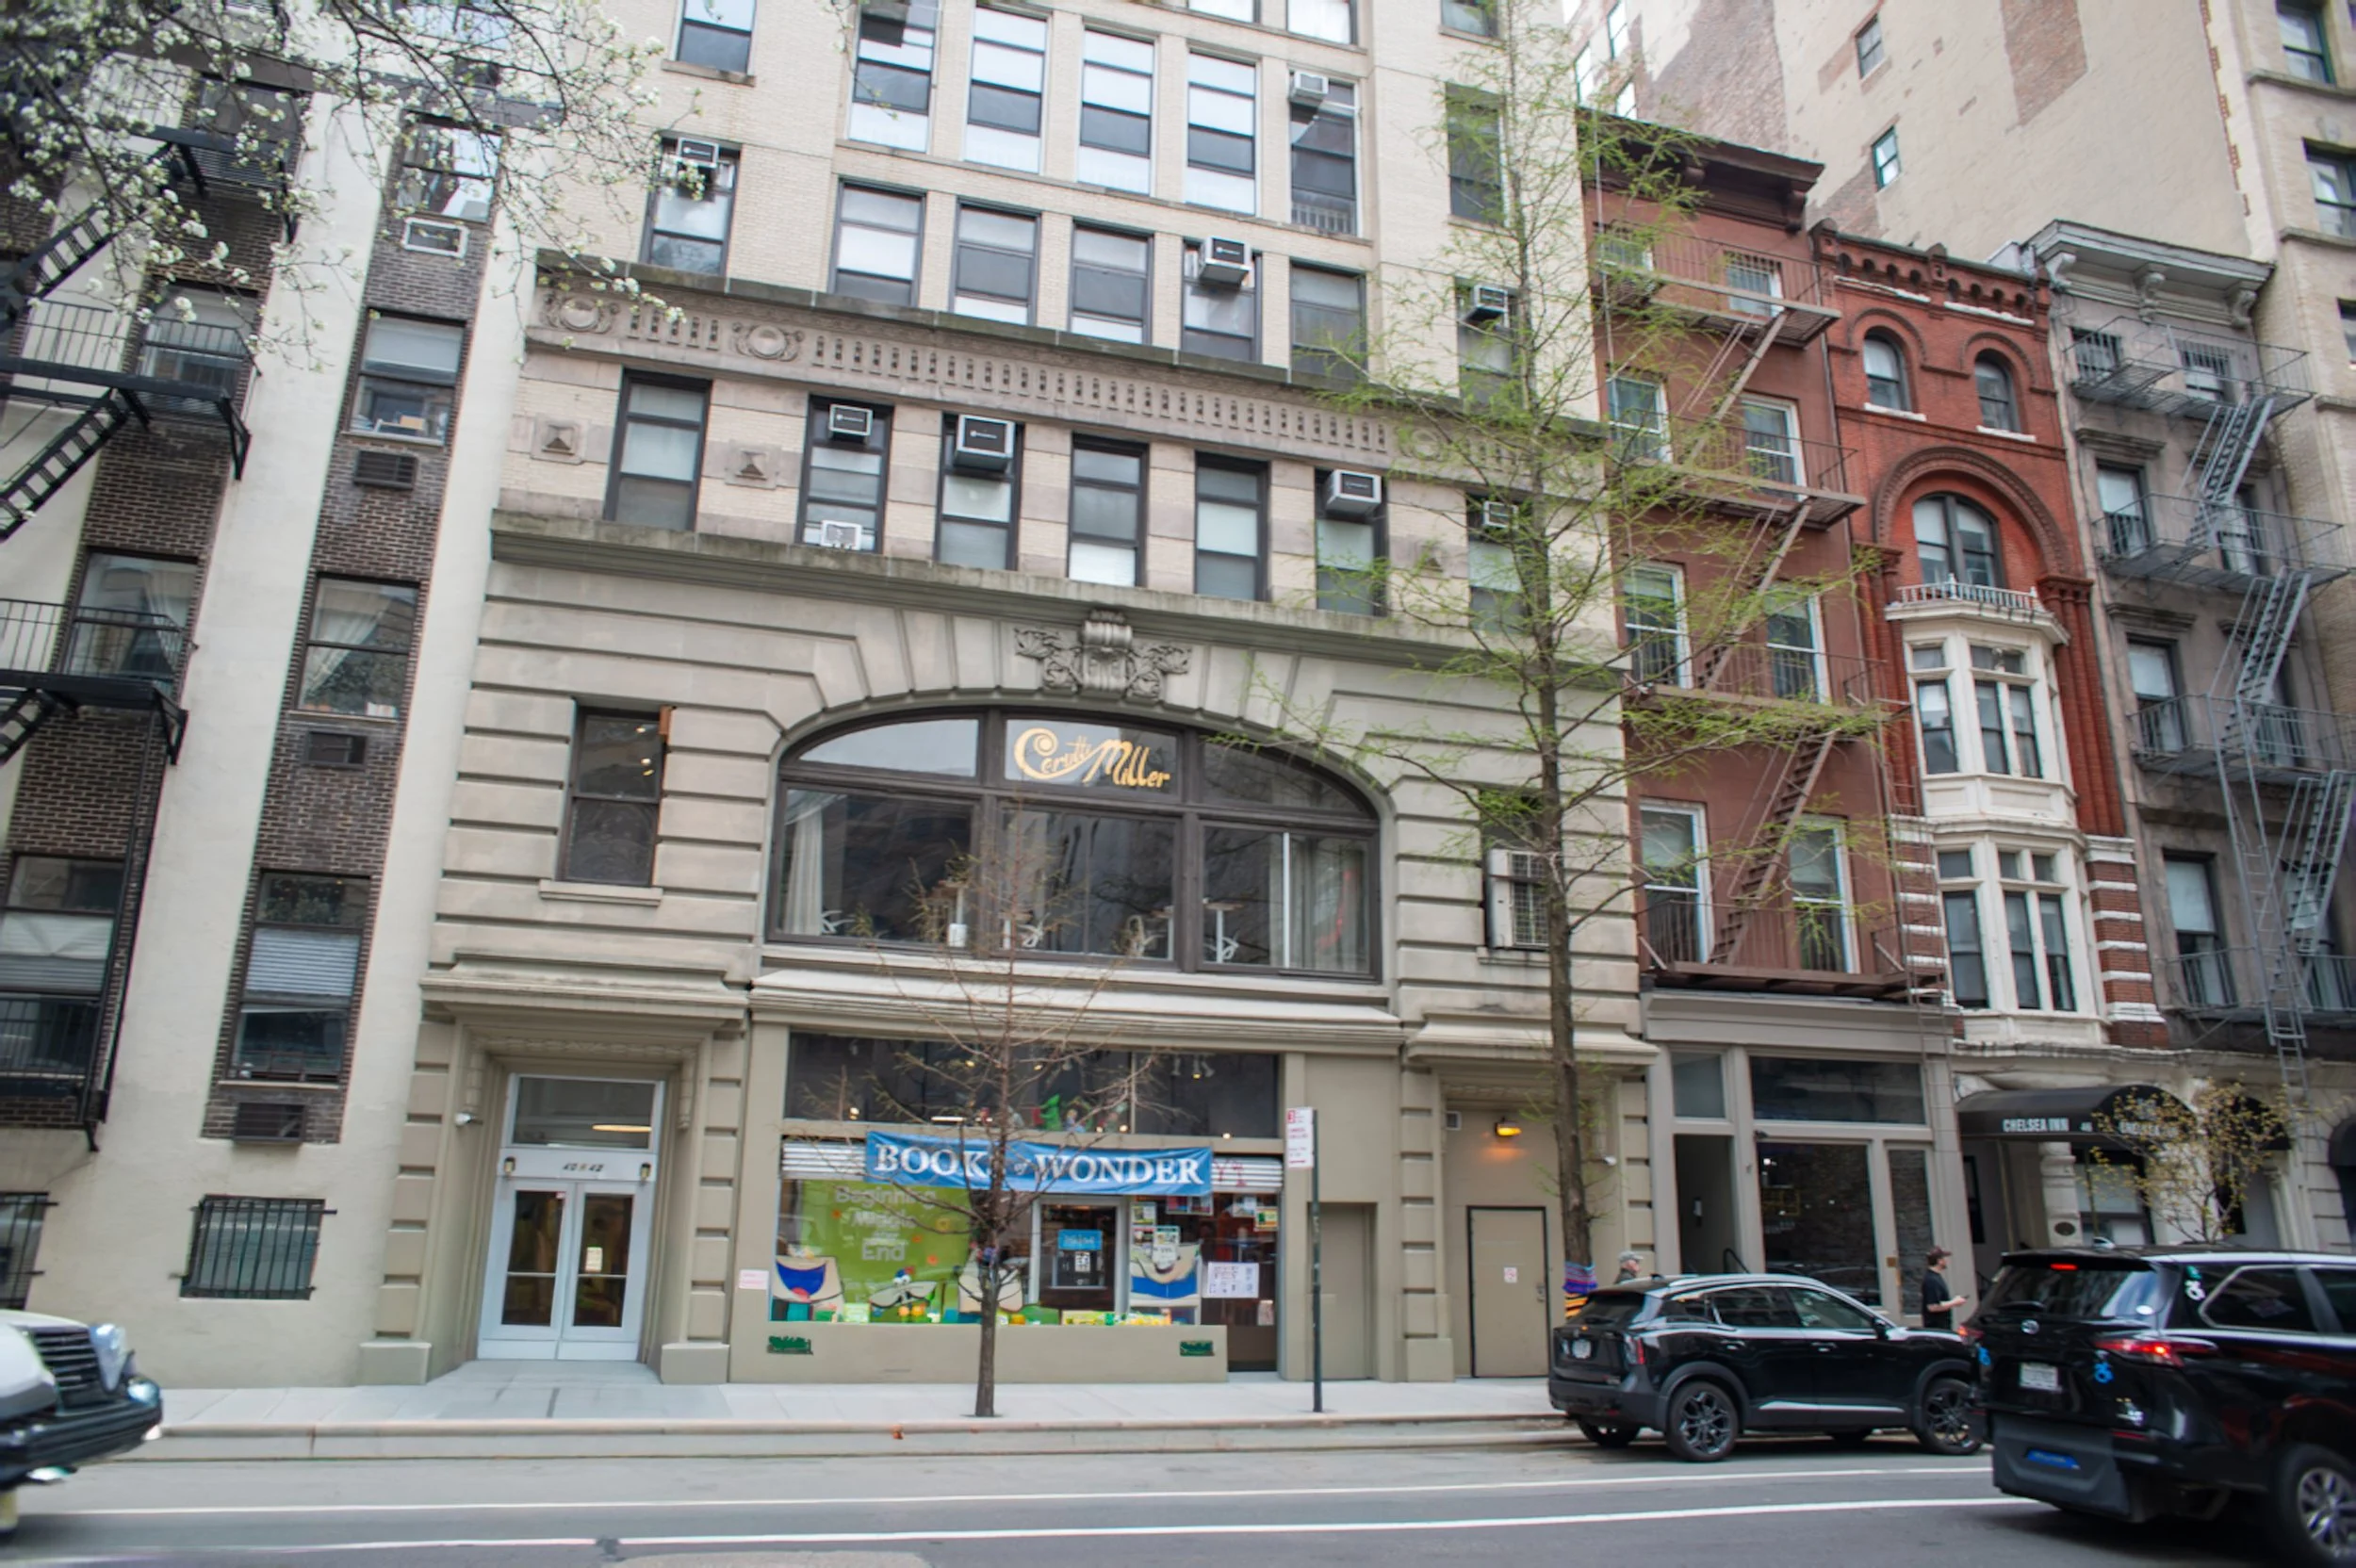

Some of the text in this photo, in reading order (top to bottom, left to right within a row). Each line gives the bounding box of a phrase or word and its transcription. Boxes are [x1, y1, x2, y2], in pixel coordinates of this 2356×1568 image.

[1082, 739, 1170, 788] Miller
[2003, 1118, 2047, 1132] CHELSEA
[1034, 1152, 1203, 1184] WONDER
